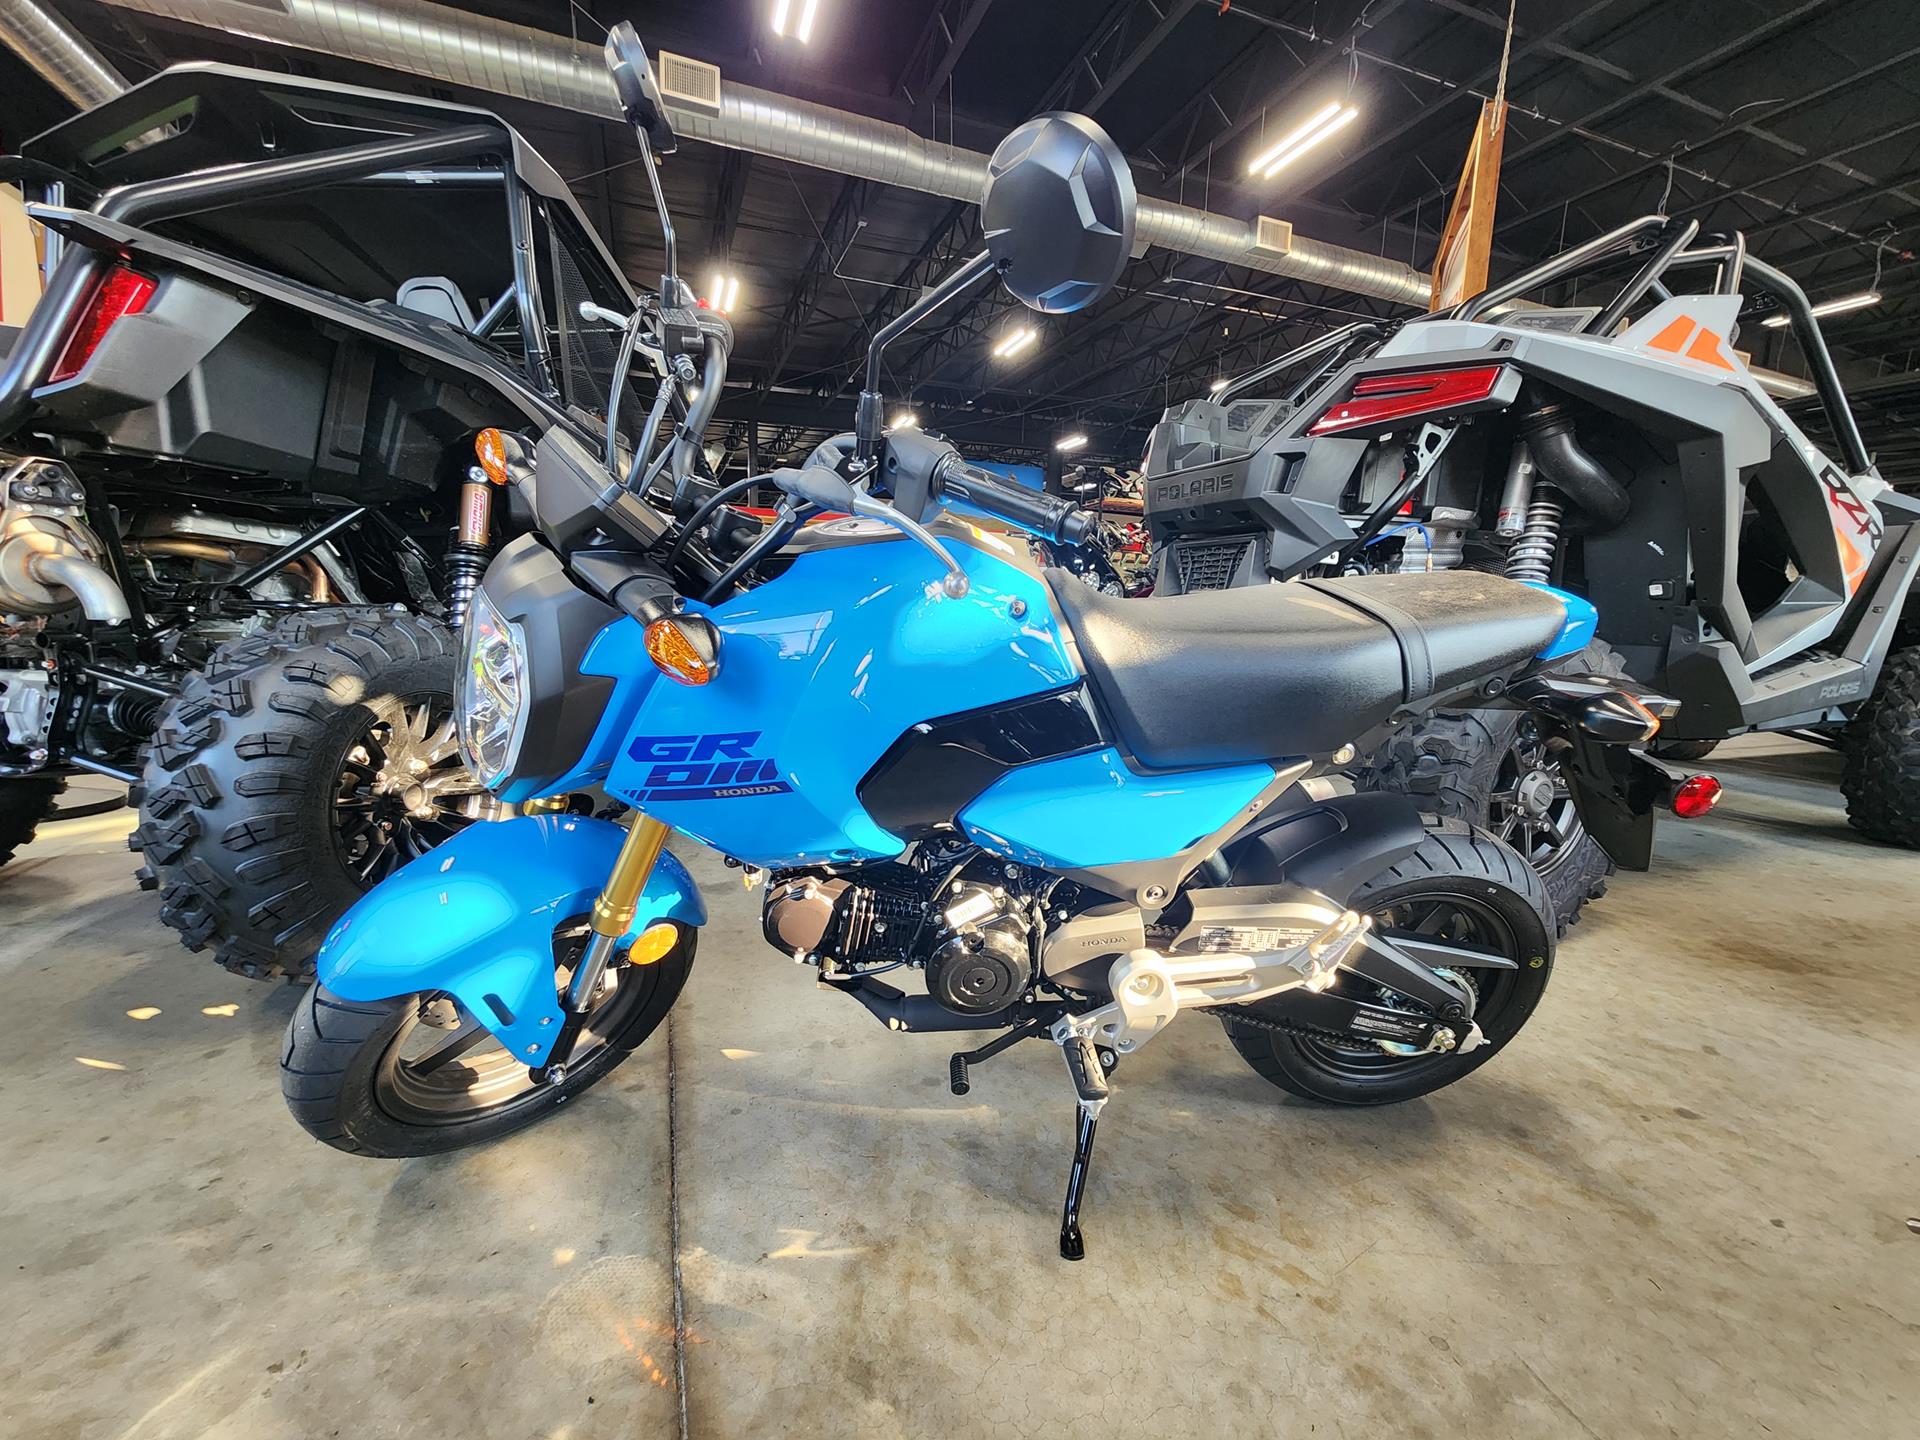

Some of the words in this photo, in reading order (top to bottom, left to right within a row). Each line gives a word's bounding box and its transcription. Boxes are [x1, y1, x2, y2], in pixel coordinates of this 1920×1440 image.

[1156, 473, 1235, 503] POLARIS
[713, 784, 783, 798] HONDA
[1080, 936, 1128, 948] HONDA
